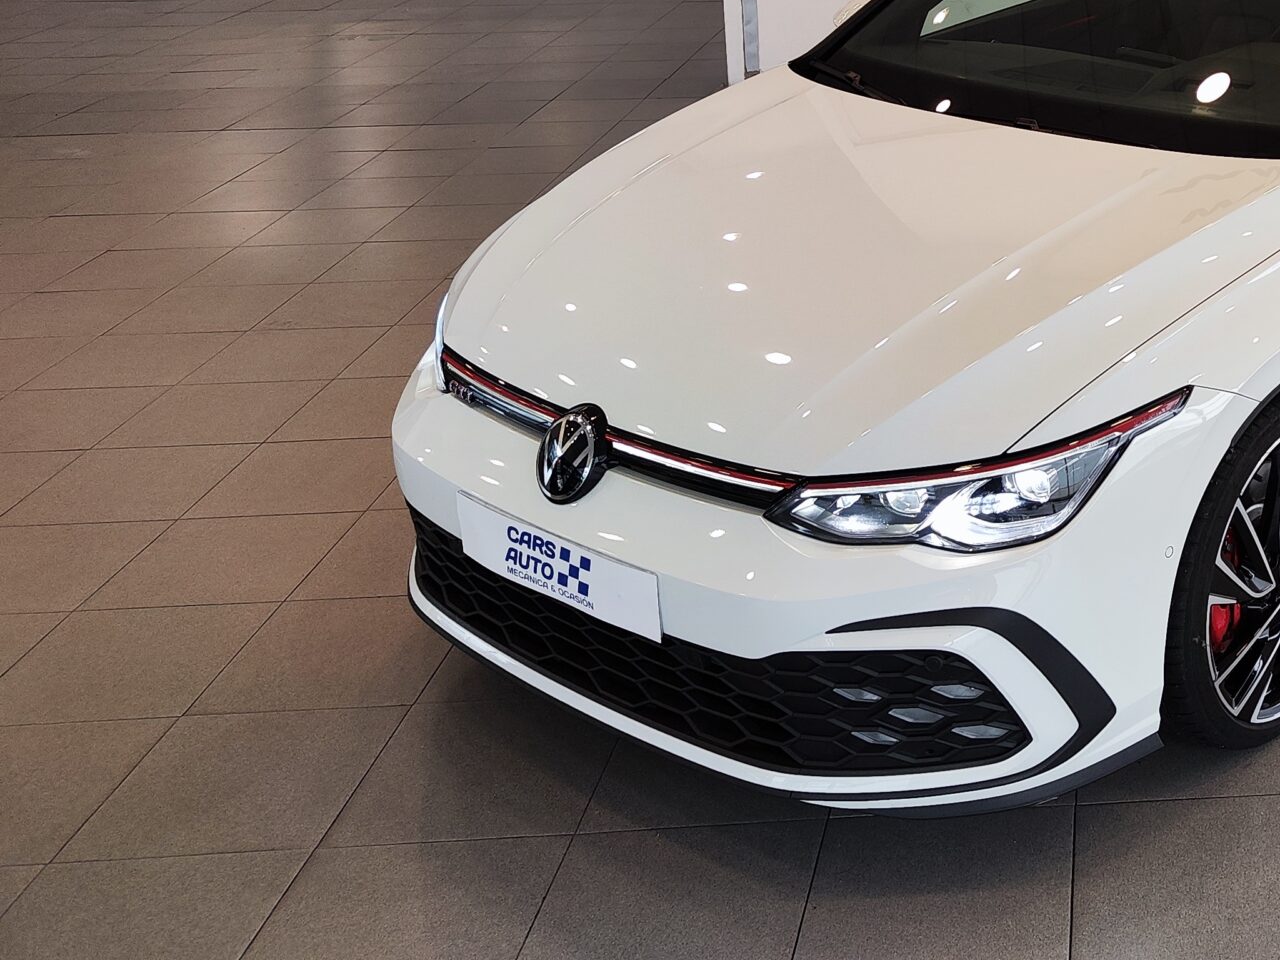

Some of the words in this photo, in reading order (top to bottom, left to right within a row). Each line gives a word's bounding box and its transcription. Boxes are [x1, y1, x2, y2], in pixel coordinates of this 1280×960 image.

[507, 526, 556, 559] CARS
[505, 547, 554, 580] AUTO
[558, 587, 594, 610] OCASIÓN
